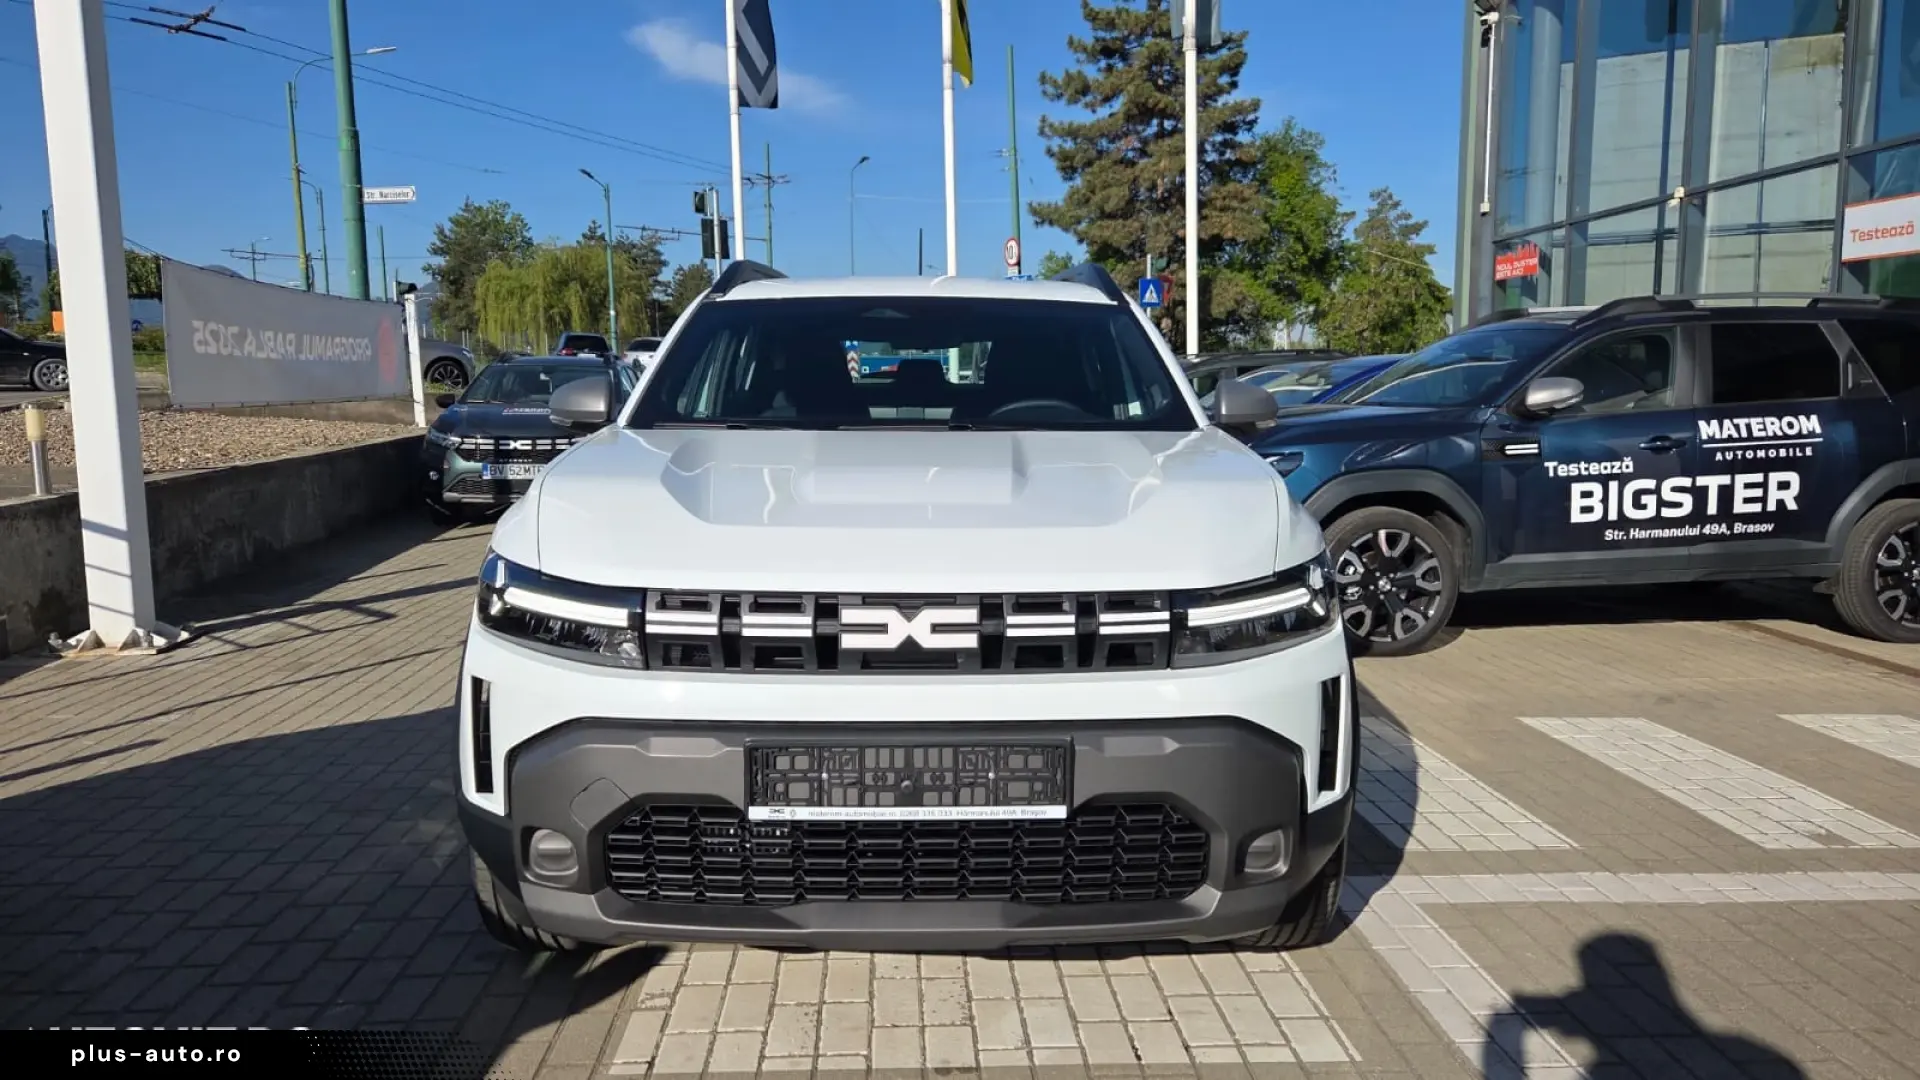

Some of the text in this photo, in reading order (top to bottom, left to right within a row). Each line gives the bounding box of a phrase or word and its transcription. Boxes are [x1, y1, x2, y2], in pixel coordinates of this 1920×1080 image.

[1849, 220, 1915, 243] Testează
[1698, 414, 1822, 440] MATEROM
[1715, 447, 1813, 461] AUTOMOBILE
[490, 465, 504, 476] BV
[1544, 456, 1633, 477] Testează
[1570, 471, 1800, 523] BIGSTER
[1604, 521, 1774, 541] Str. Harmanului 49A, Brasov
